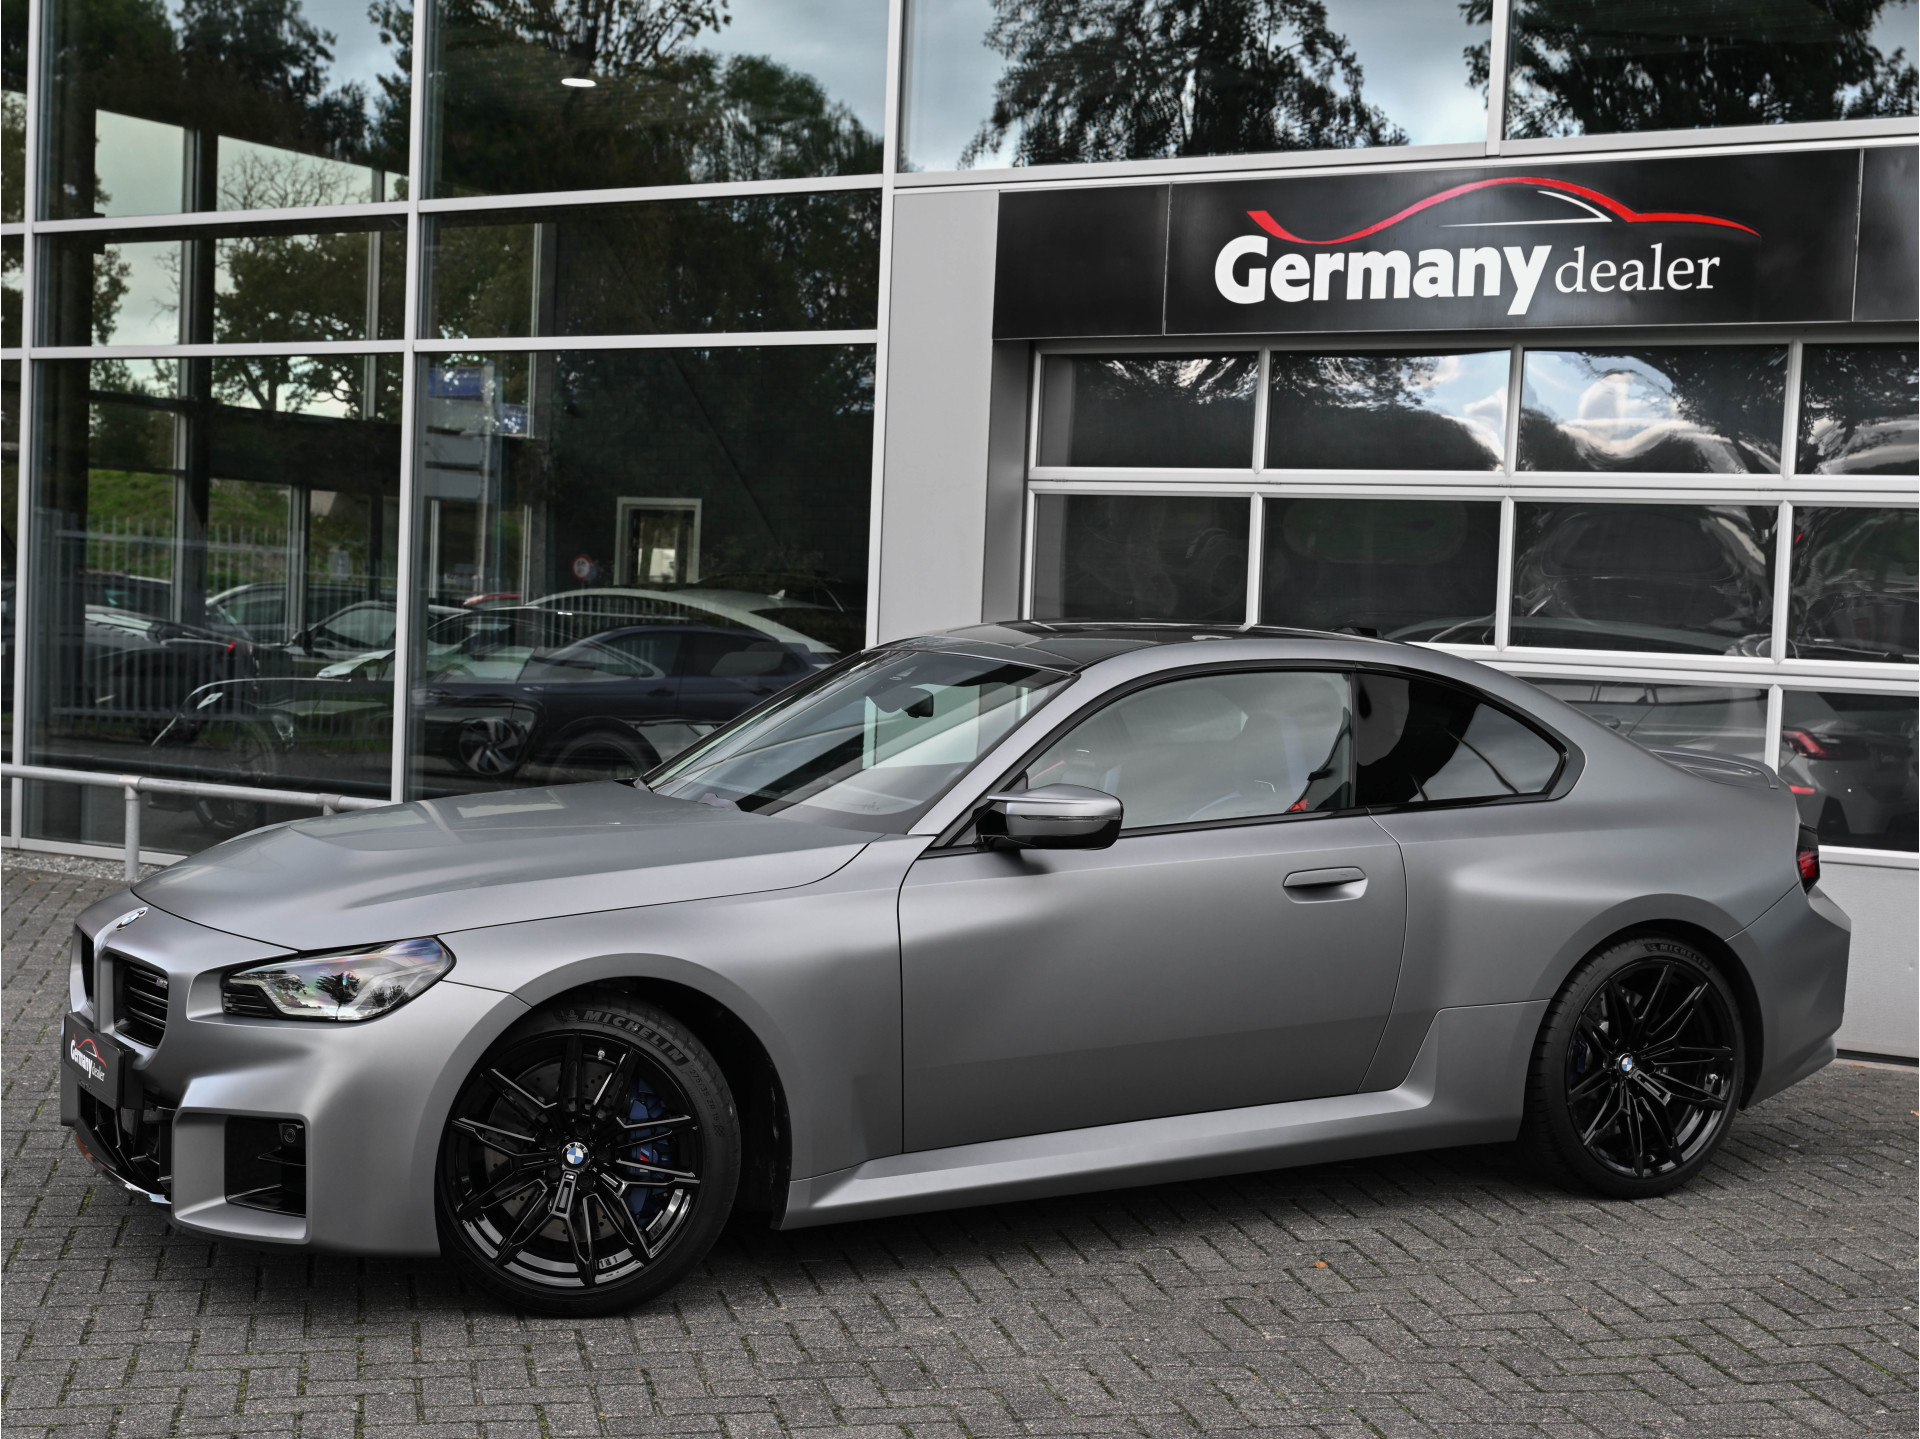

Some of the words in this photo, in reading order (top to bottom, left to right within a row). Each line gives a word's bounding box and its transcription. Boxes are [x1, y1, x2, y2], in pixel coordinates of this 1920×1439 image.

[1214, 234, 1553, 315] Germany
[1554, 242, 1720, 293] dealer
[1659, 943, 1709, 969] MICHELIN
[583, 1010, 685, 1062] MICHELIN
[71, 1039, 93, 1079] Germany
[92, 1063, 105, 1081] dealer
